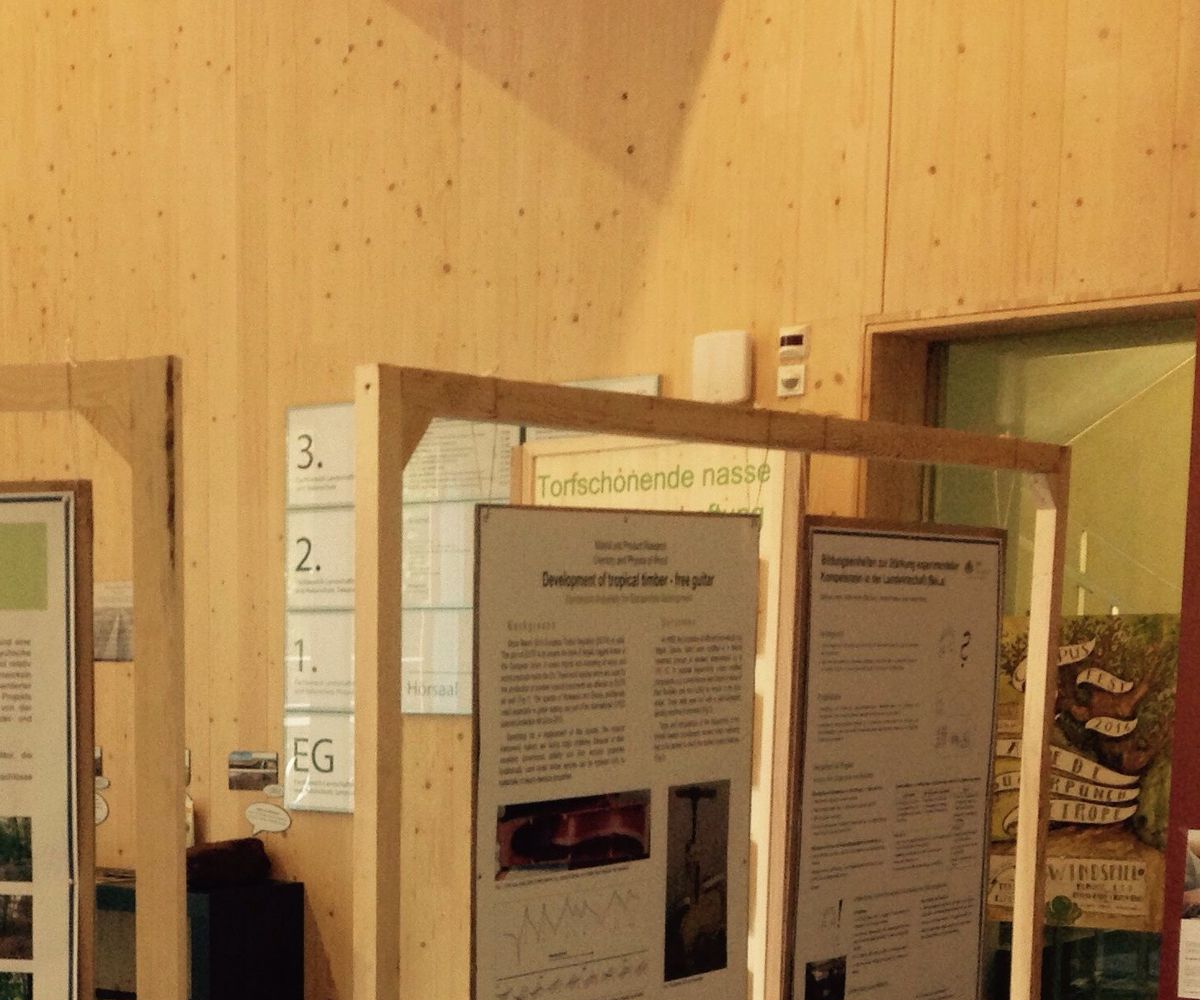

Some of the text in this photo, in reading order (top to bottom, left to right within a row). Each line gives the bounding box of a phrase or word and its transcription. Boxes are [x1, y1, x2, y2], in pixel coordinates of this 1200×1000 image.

[296, 433, 323, 470] 3.
[702, 462, 771, 489] nasse
[295, 536, 321, 572] 2.
[293, 638, 317, 672] 1.
[293, 738, 334, 774] EG
